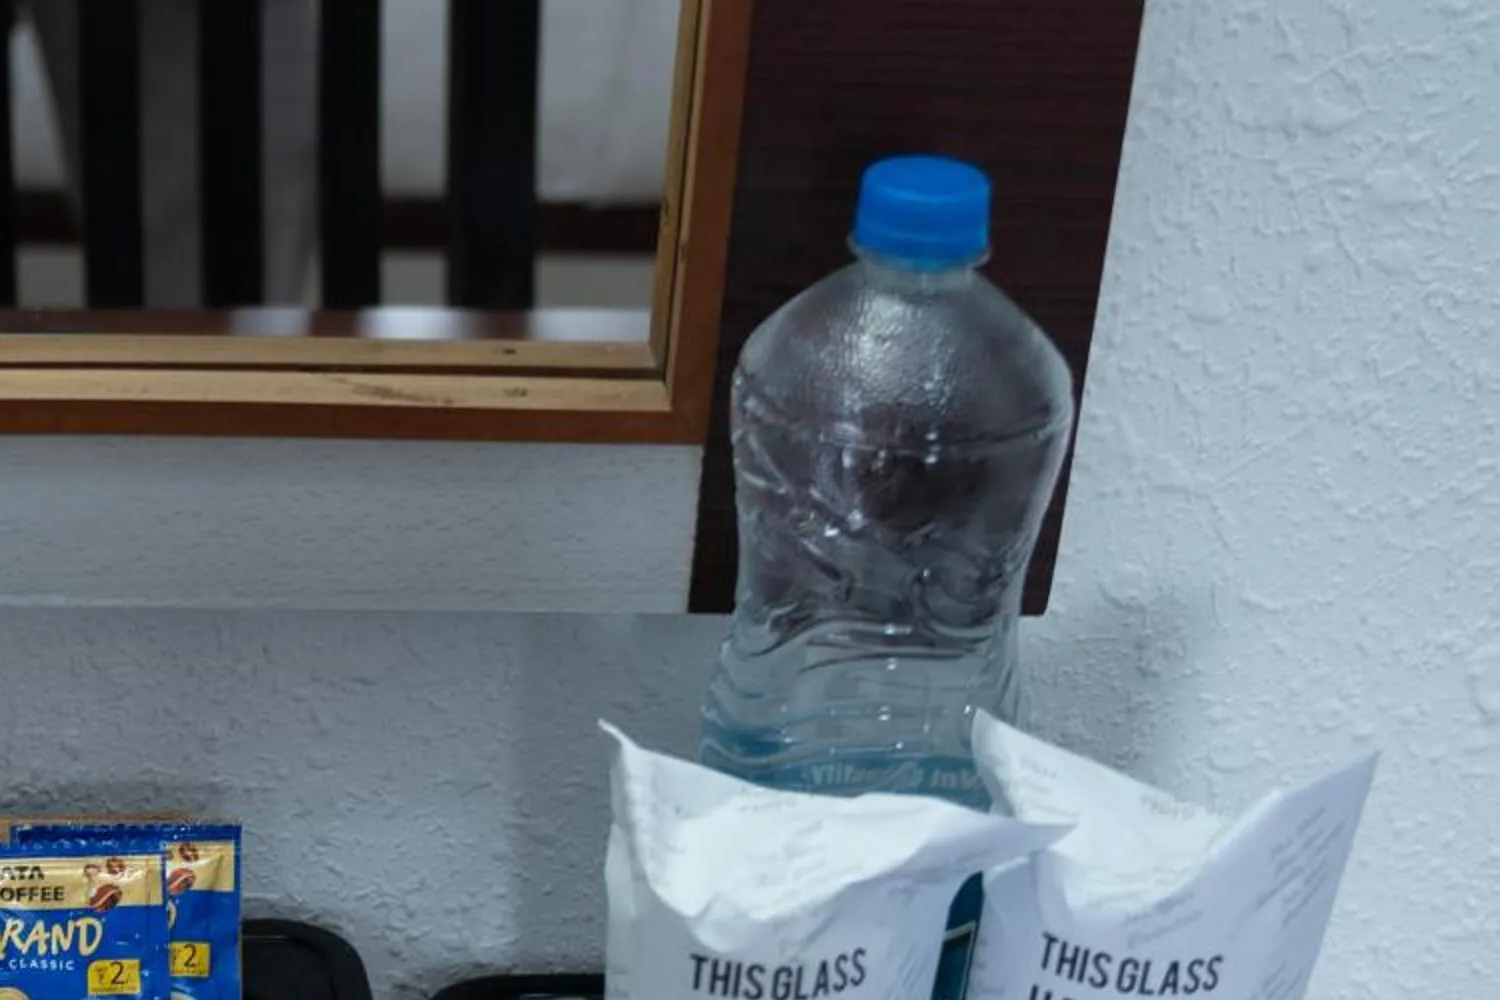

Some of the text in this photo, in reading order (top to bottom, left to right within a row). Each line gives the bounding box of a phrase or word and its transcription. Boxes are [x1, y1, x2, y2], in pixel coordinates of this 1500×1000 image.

[8, 959, 74, 971] CLASSIC
[1039, 932, 1224, 998] THIS GLASS
